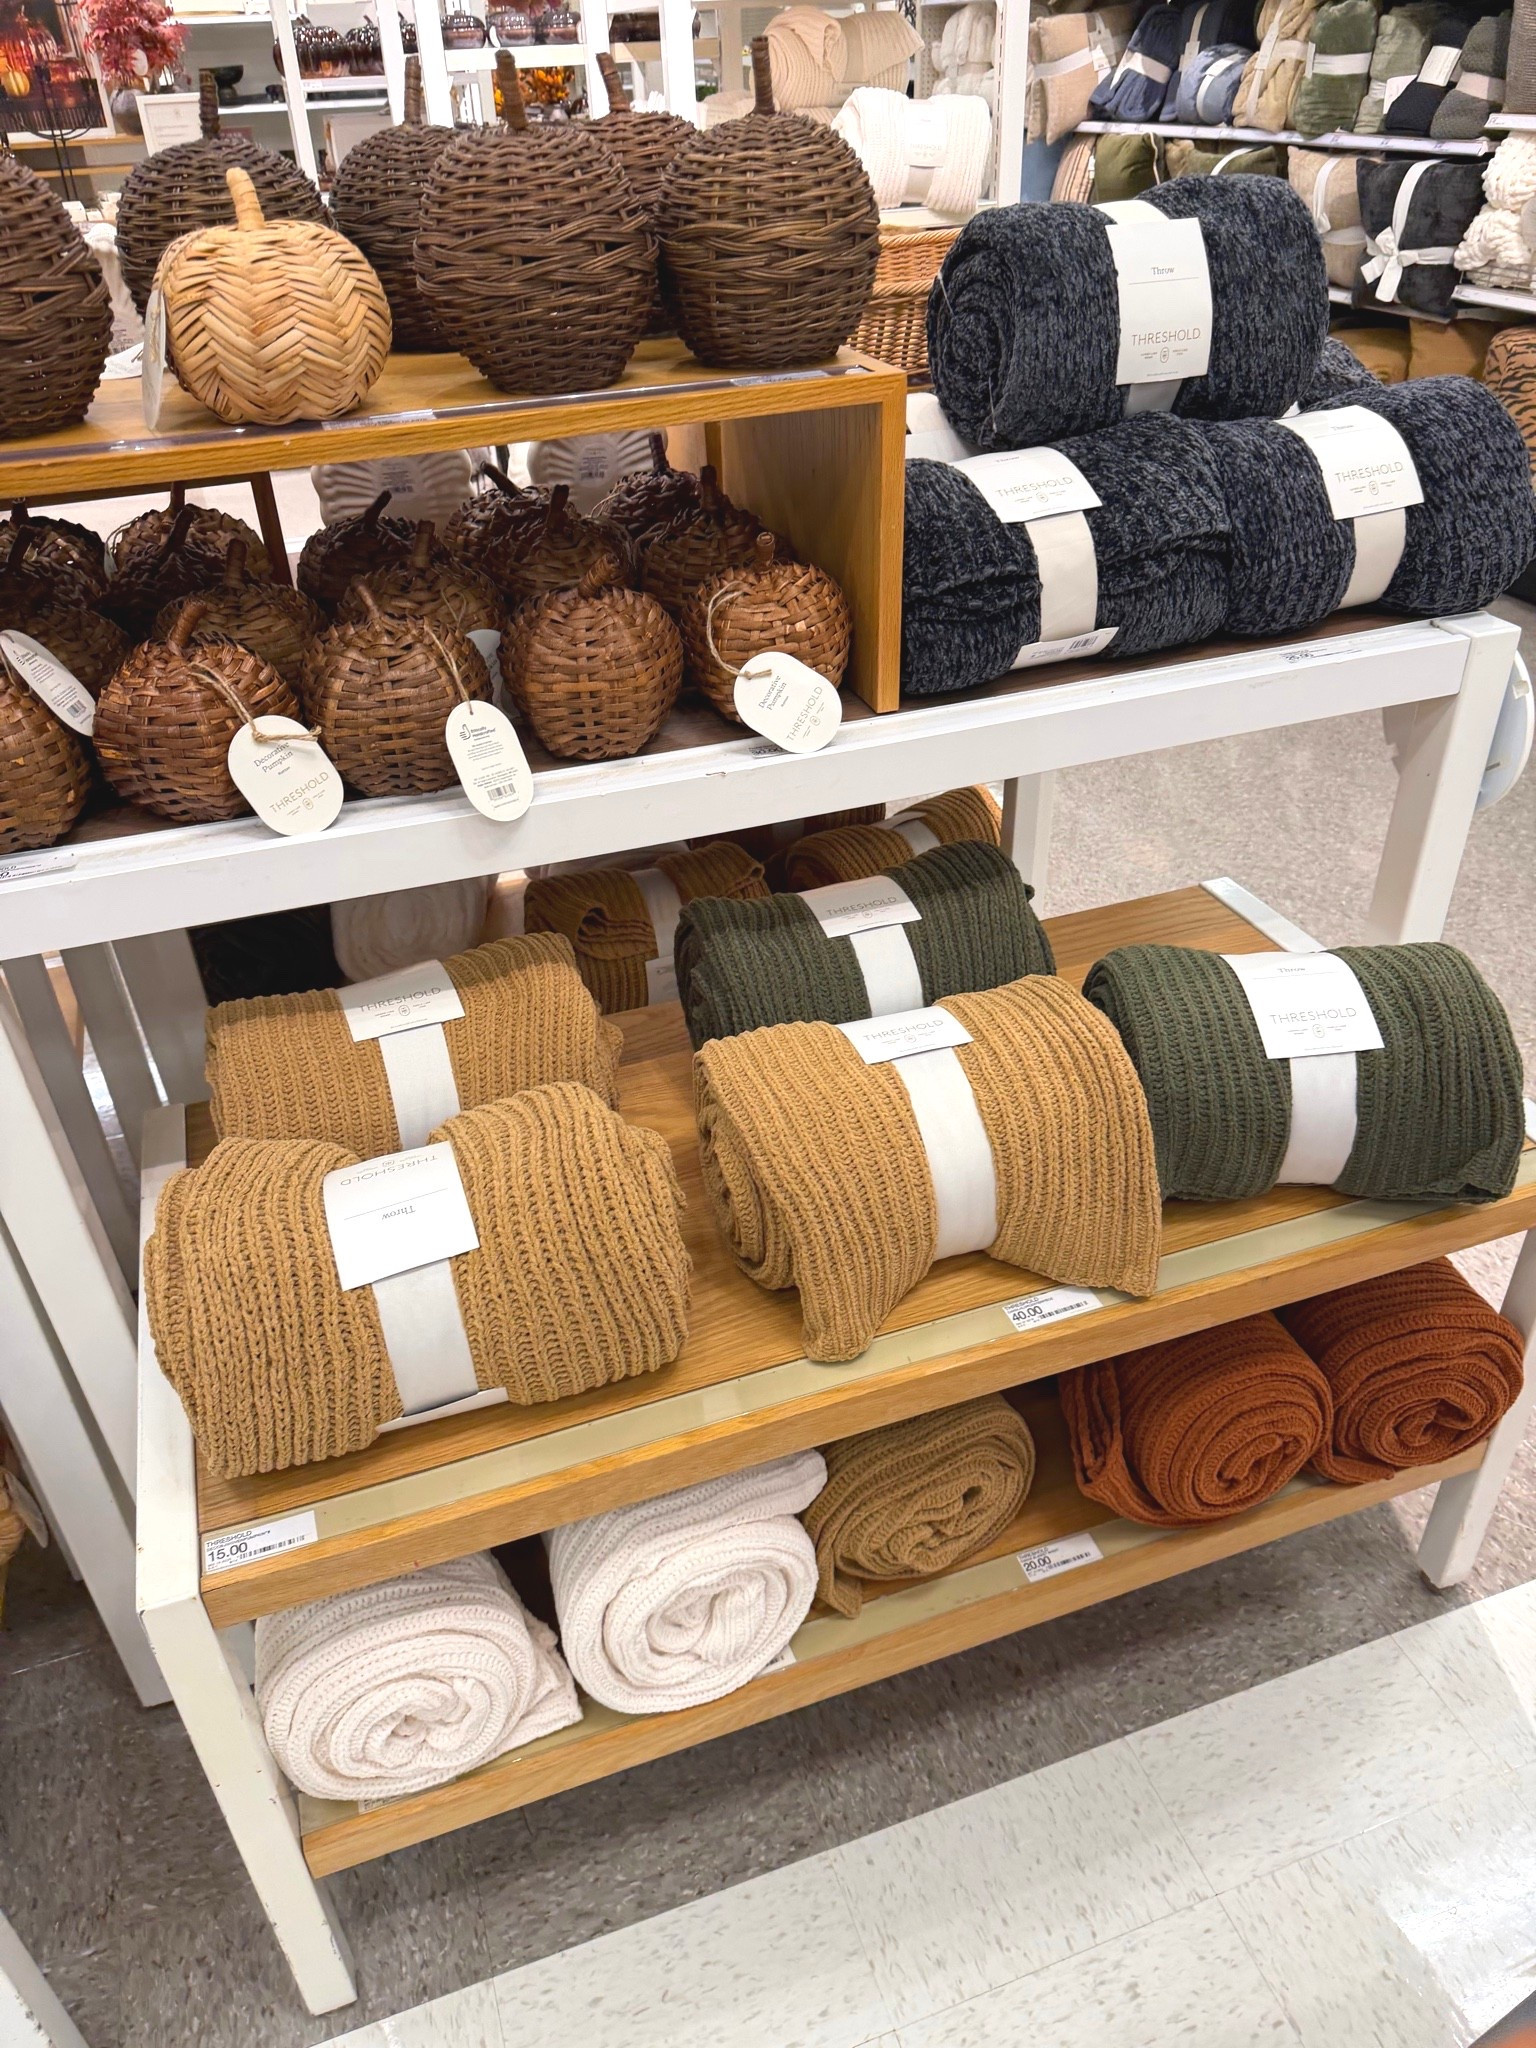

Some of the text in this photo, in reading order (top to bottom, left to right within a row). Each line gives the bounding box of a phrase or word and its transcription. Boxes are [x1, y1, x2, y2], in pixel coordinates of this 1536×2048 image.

[1151, 266, 1175, 275] Throw
[1131, 327, 1201, 346] THRESHOLD
[1334, 461, 1403, 483] THRESHOLD
[995, 476, 1073, 497] THRESHOLD
[758, 675, 781, 709] Decorative
[766, 682, 787, 711] Pumpkin
[786, 686, 823, 741] THRESHOLD
[253, 742, 290, 767] Decorative
[262, 750, 294, 773] Pumpkin
[269, 771, 329, 813] THRESHOLD
[826, 896, 897, 917] THRESHOLD
[360, 987, 441, 1012] THRESHOLD
[1269, 1007, 1357, 1025] THRESHOLD
[863, 1019, 944, 1041] THRESHOLD
[340, 1155, 438, 1186] THRESHOLD
[381, 1205, 416, 1220] Throw
[1012, 1305, 1043, 1321] 40.00
[206, 1530, 252, 1548] THRESHOLD
[208, 1542, 248, 1562] 15.00
[1023, 1555, 1051, 1572] 20.00
